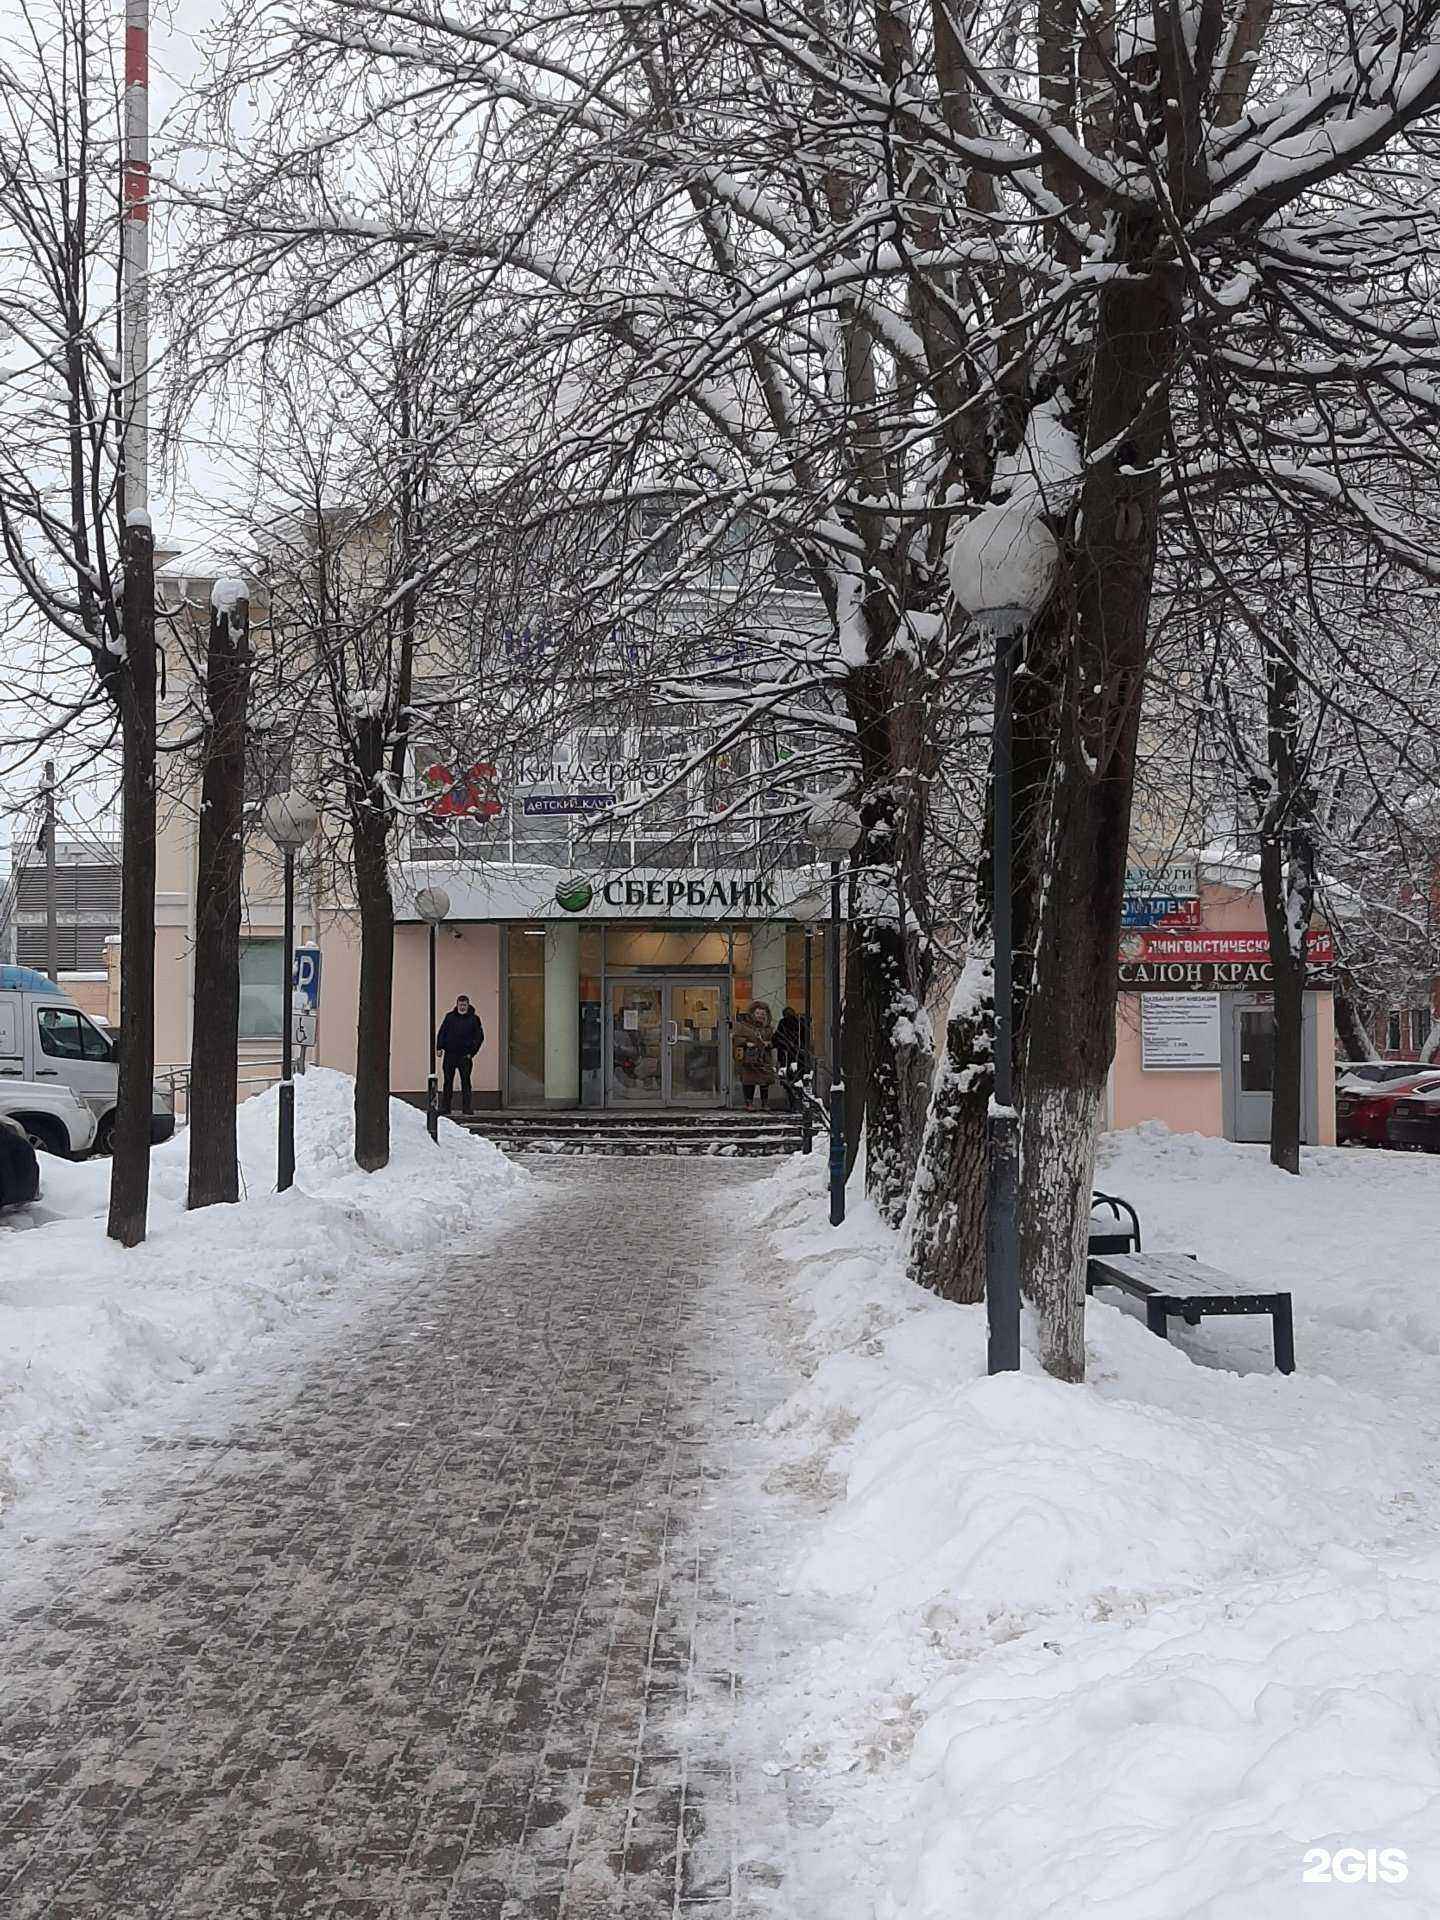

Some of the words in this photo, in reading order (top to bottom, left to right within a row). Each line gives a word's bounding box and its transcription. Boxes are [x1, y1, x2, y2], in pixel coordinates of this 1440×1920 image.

[603, 880, 777, 906] СБЕРБАНК
[1117, 963, 1202, 983] САЛОН
[1212, 962, 1276, 983] КРАС
